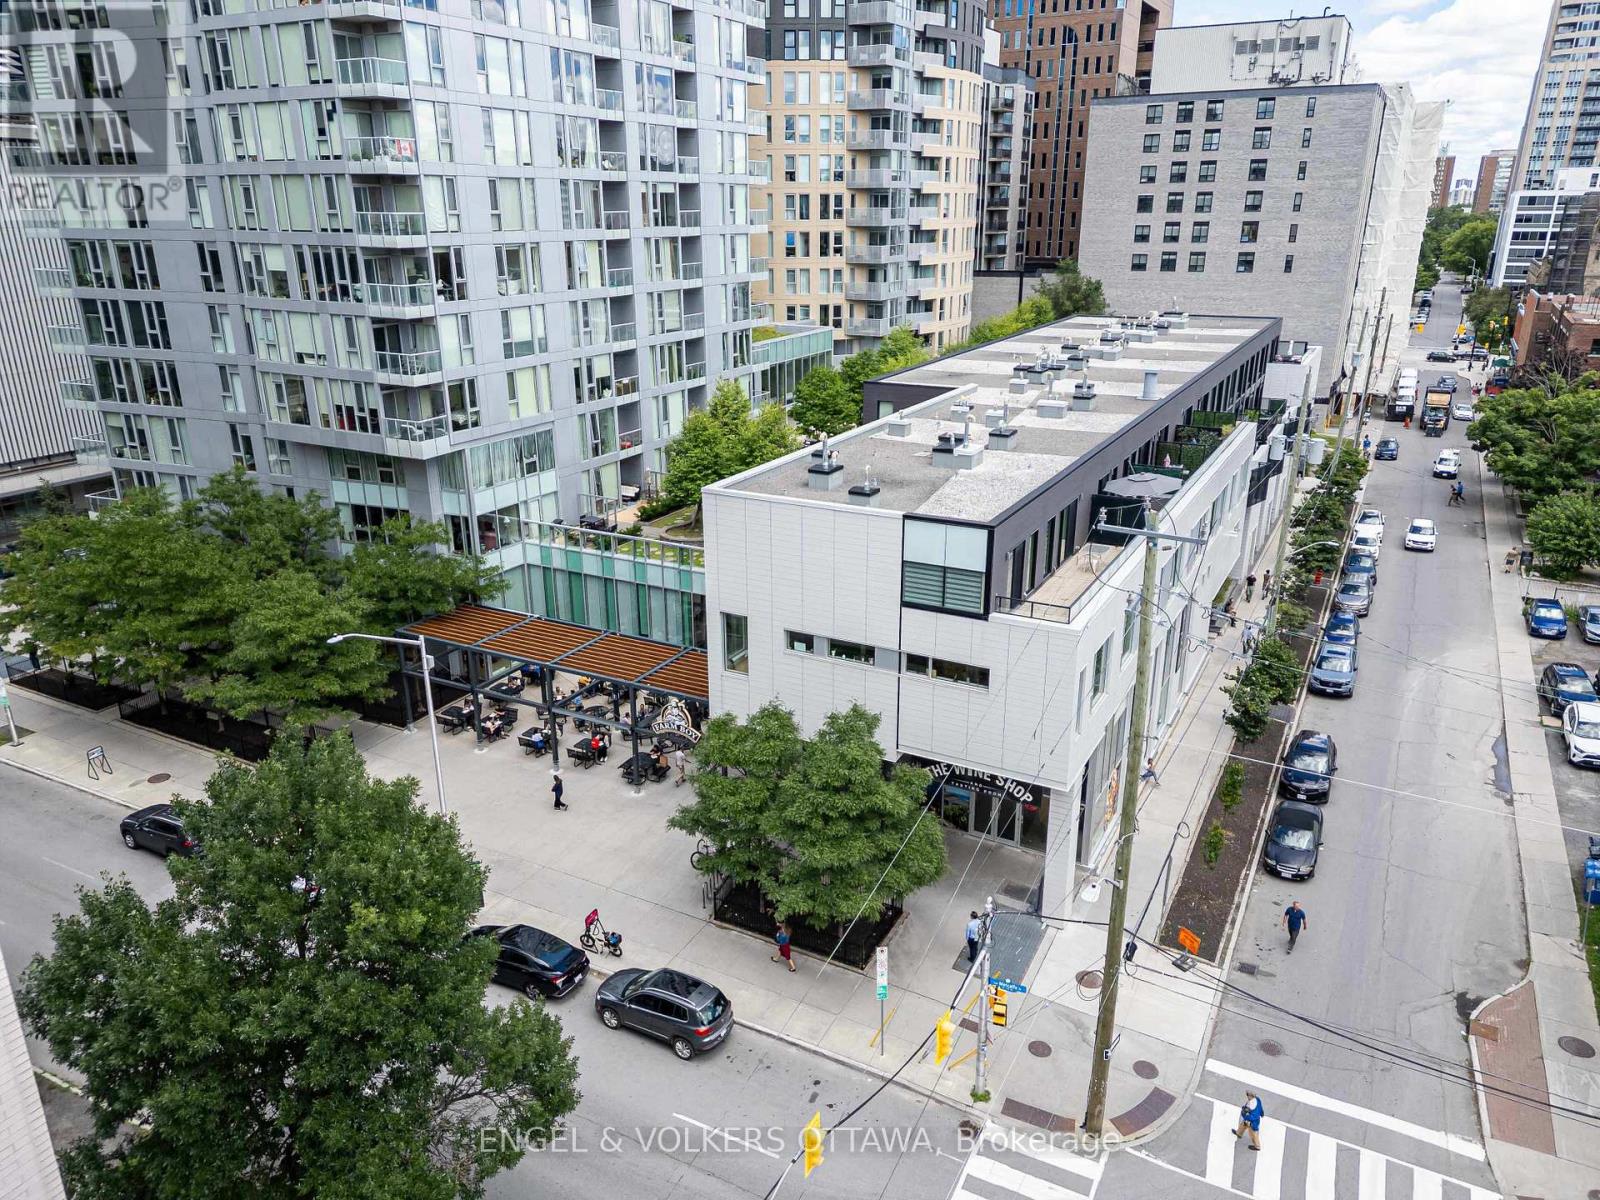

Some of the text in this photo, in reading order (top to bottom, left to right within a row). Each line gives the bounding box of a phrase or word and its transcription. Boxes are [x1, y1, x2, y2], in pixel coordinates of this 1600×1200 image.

[654, 722, 697, 738] FARM BOY
[923, 763, 1033, 802] THE WINE SHOP
